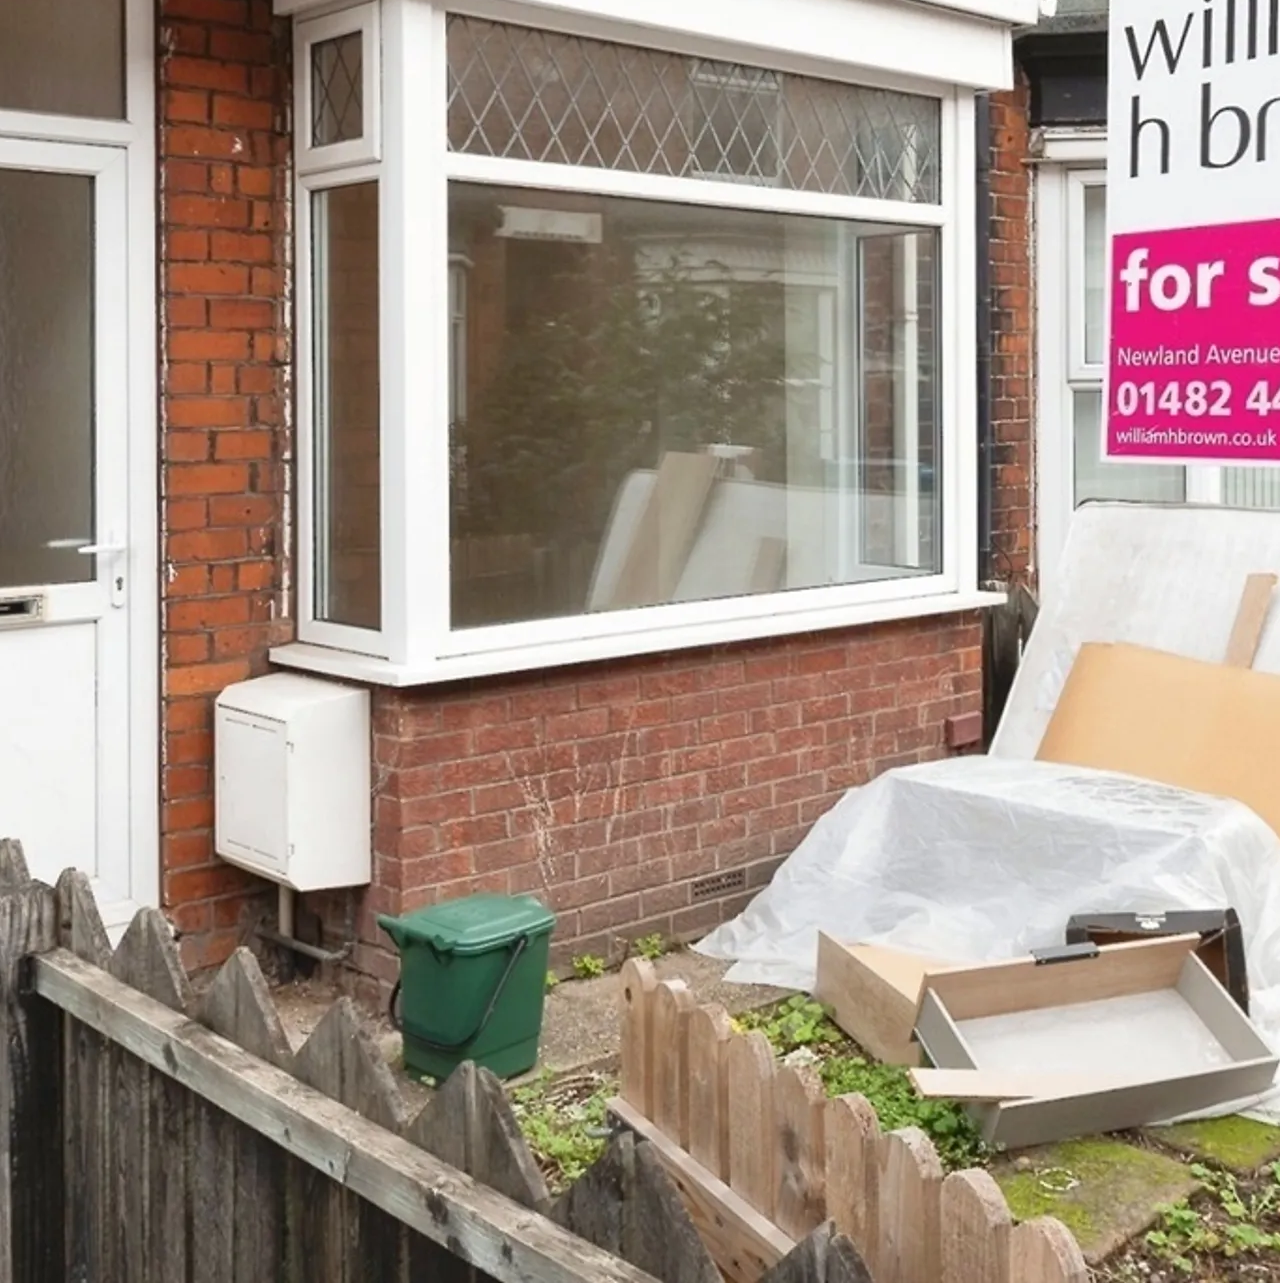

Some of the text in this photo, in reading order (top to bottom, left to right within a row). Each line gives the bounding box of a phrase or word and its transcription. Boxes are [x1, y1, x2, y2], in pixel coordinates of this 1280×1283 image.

[1129, 94, 1171, 179] h
[1120, 248, 1225, 312] for
[1117, 344, 1200, 366] Newland
[1116, 380, 1232, 417] 01482
[1116, 426, 1278, 447] williamhbrown.co.uk
